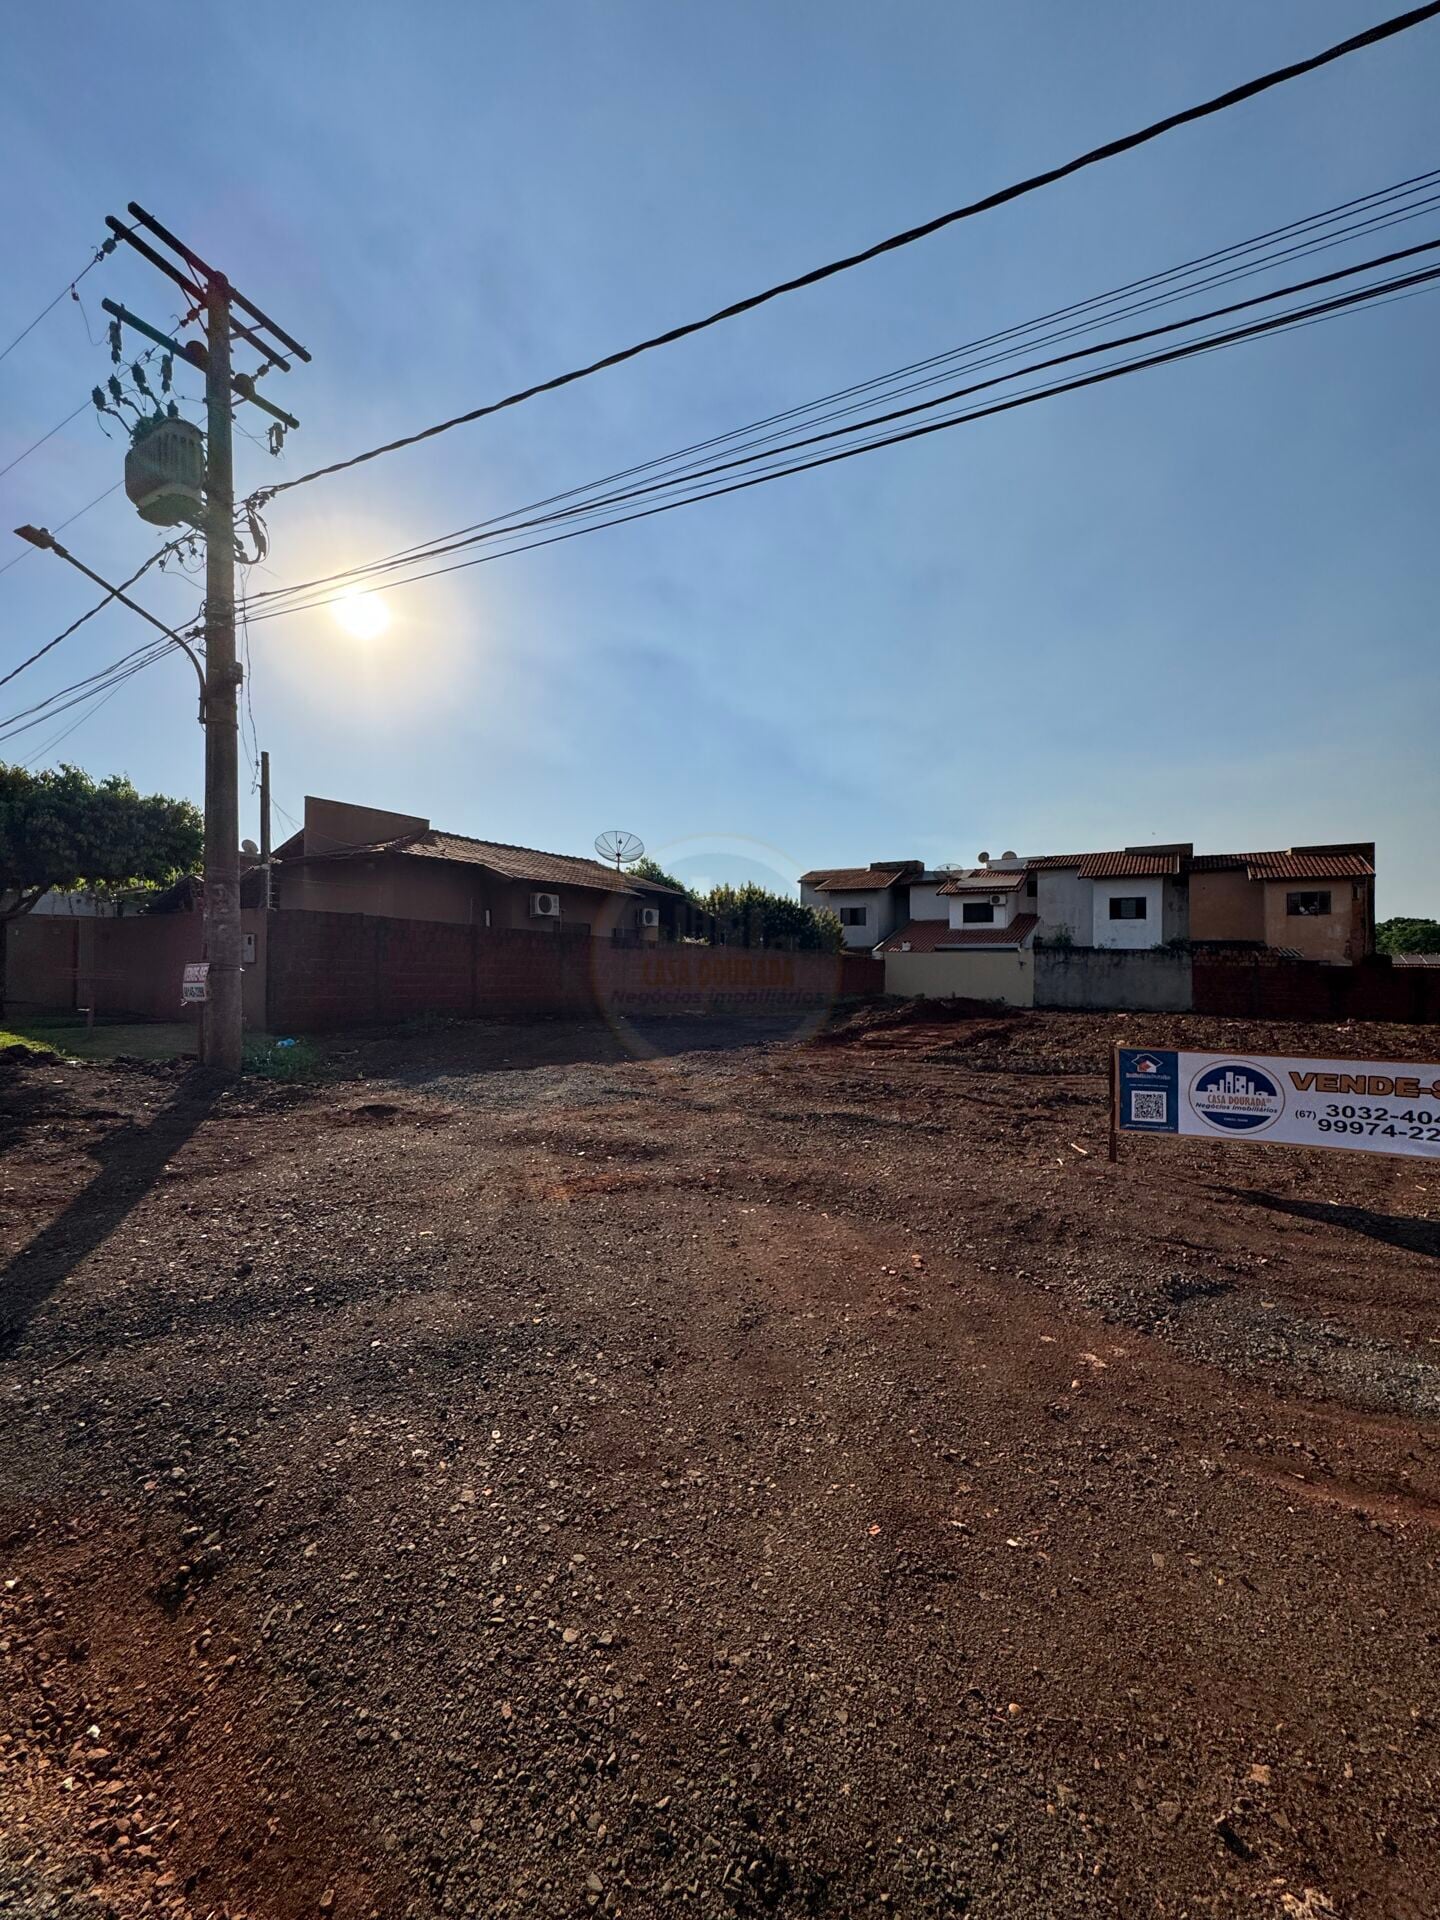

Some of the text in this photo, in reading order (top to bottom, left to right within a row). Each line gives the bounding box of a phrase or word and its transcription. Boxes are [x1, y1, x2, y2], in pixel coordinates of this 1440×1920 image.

[1195, 1102, 1230, 1111] Negócios
[1207, 1094, 1226, 1104] CASA
[1228, 1096, 1267, 1107] DOURADA
[1295, 1109, 1317, 1120] (67)
[1317, 1118, 1440, 1142] 99974-22
